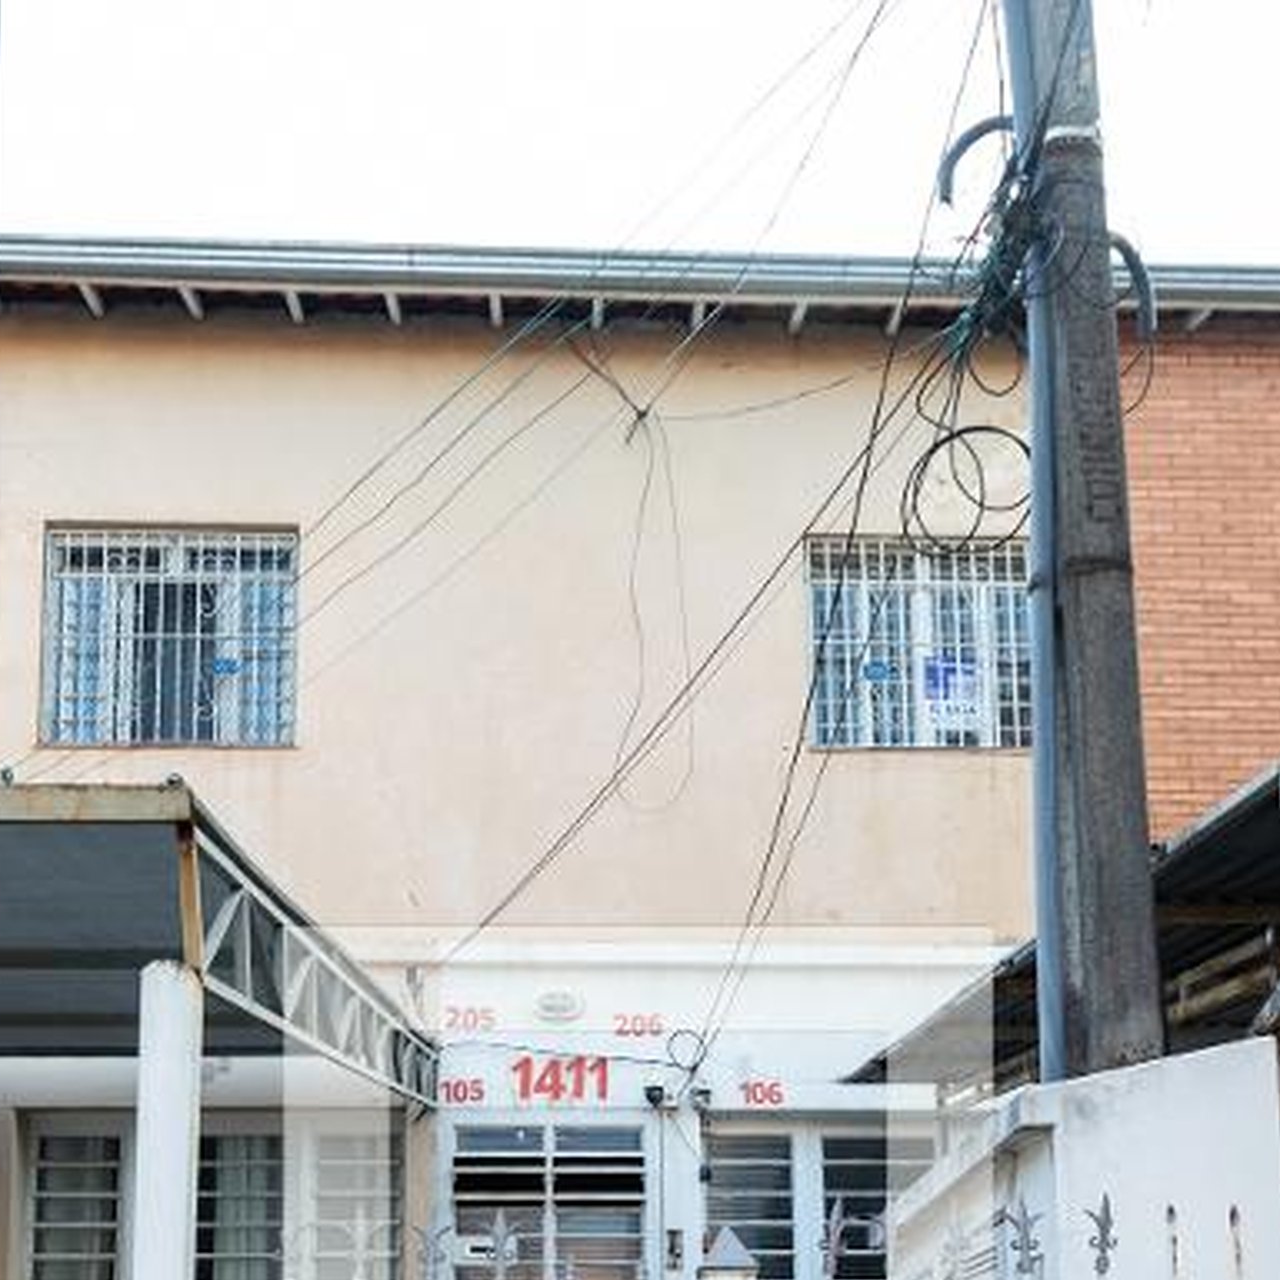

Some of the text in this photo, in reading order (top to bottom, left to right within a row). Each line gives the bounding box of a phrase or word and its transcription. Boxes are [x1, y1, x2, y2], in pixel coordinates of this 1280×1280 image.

[446, 1006, 495, 1032] 205
[614, 1013, 664, 1037] 206
[512, 1056, 609, 1100] 1411
[441, 1079, 485, 1103] 105
[740, 1081, 783, 1104] 106
